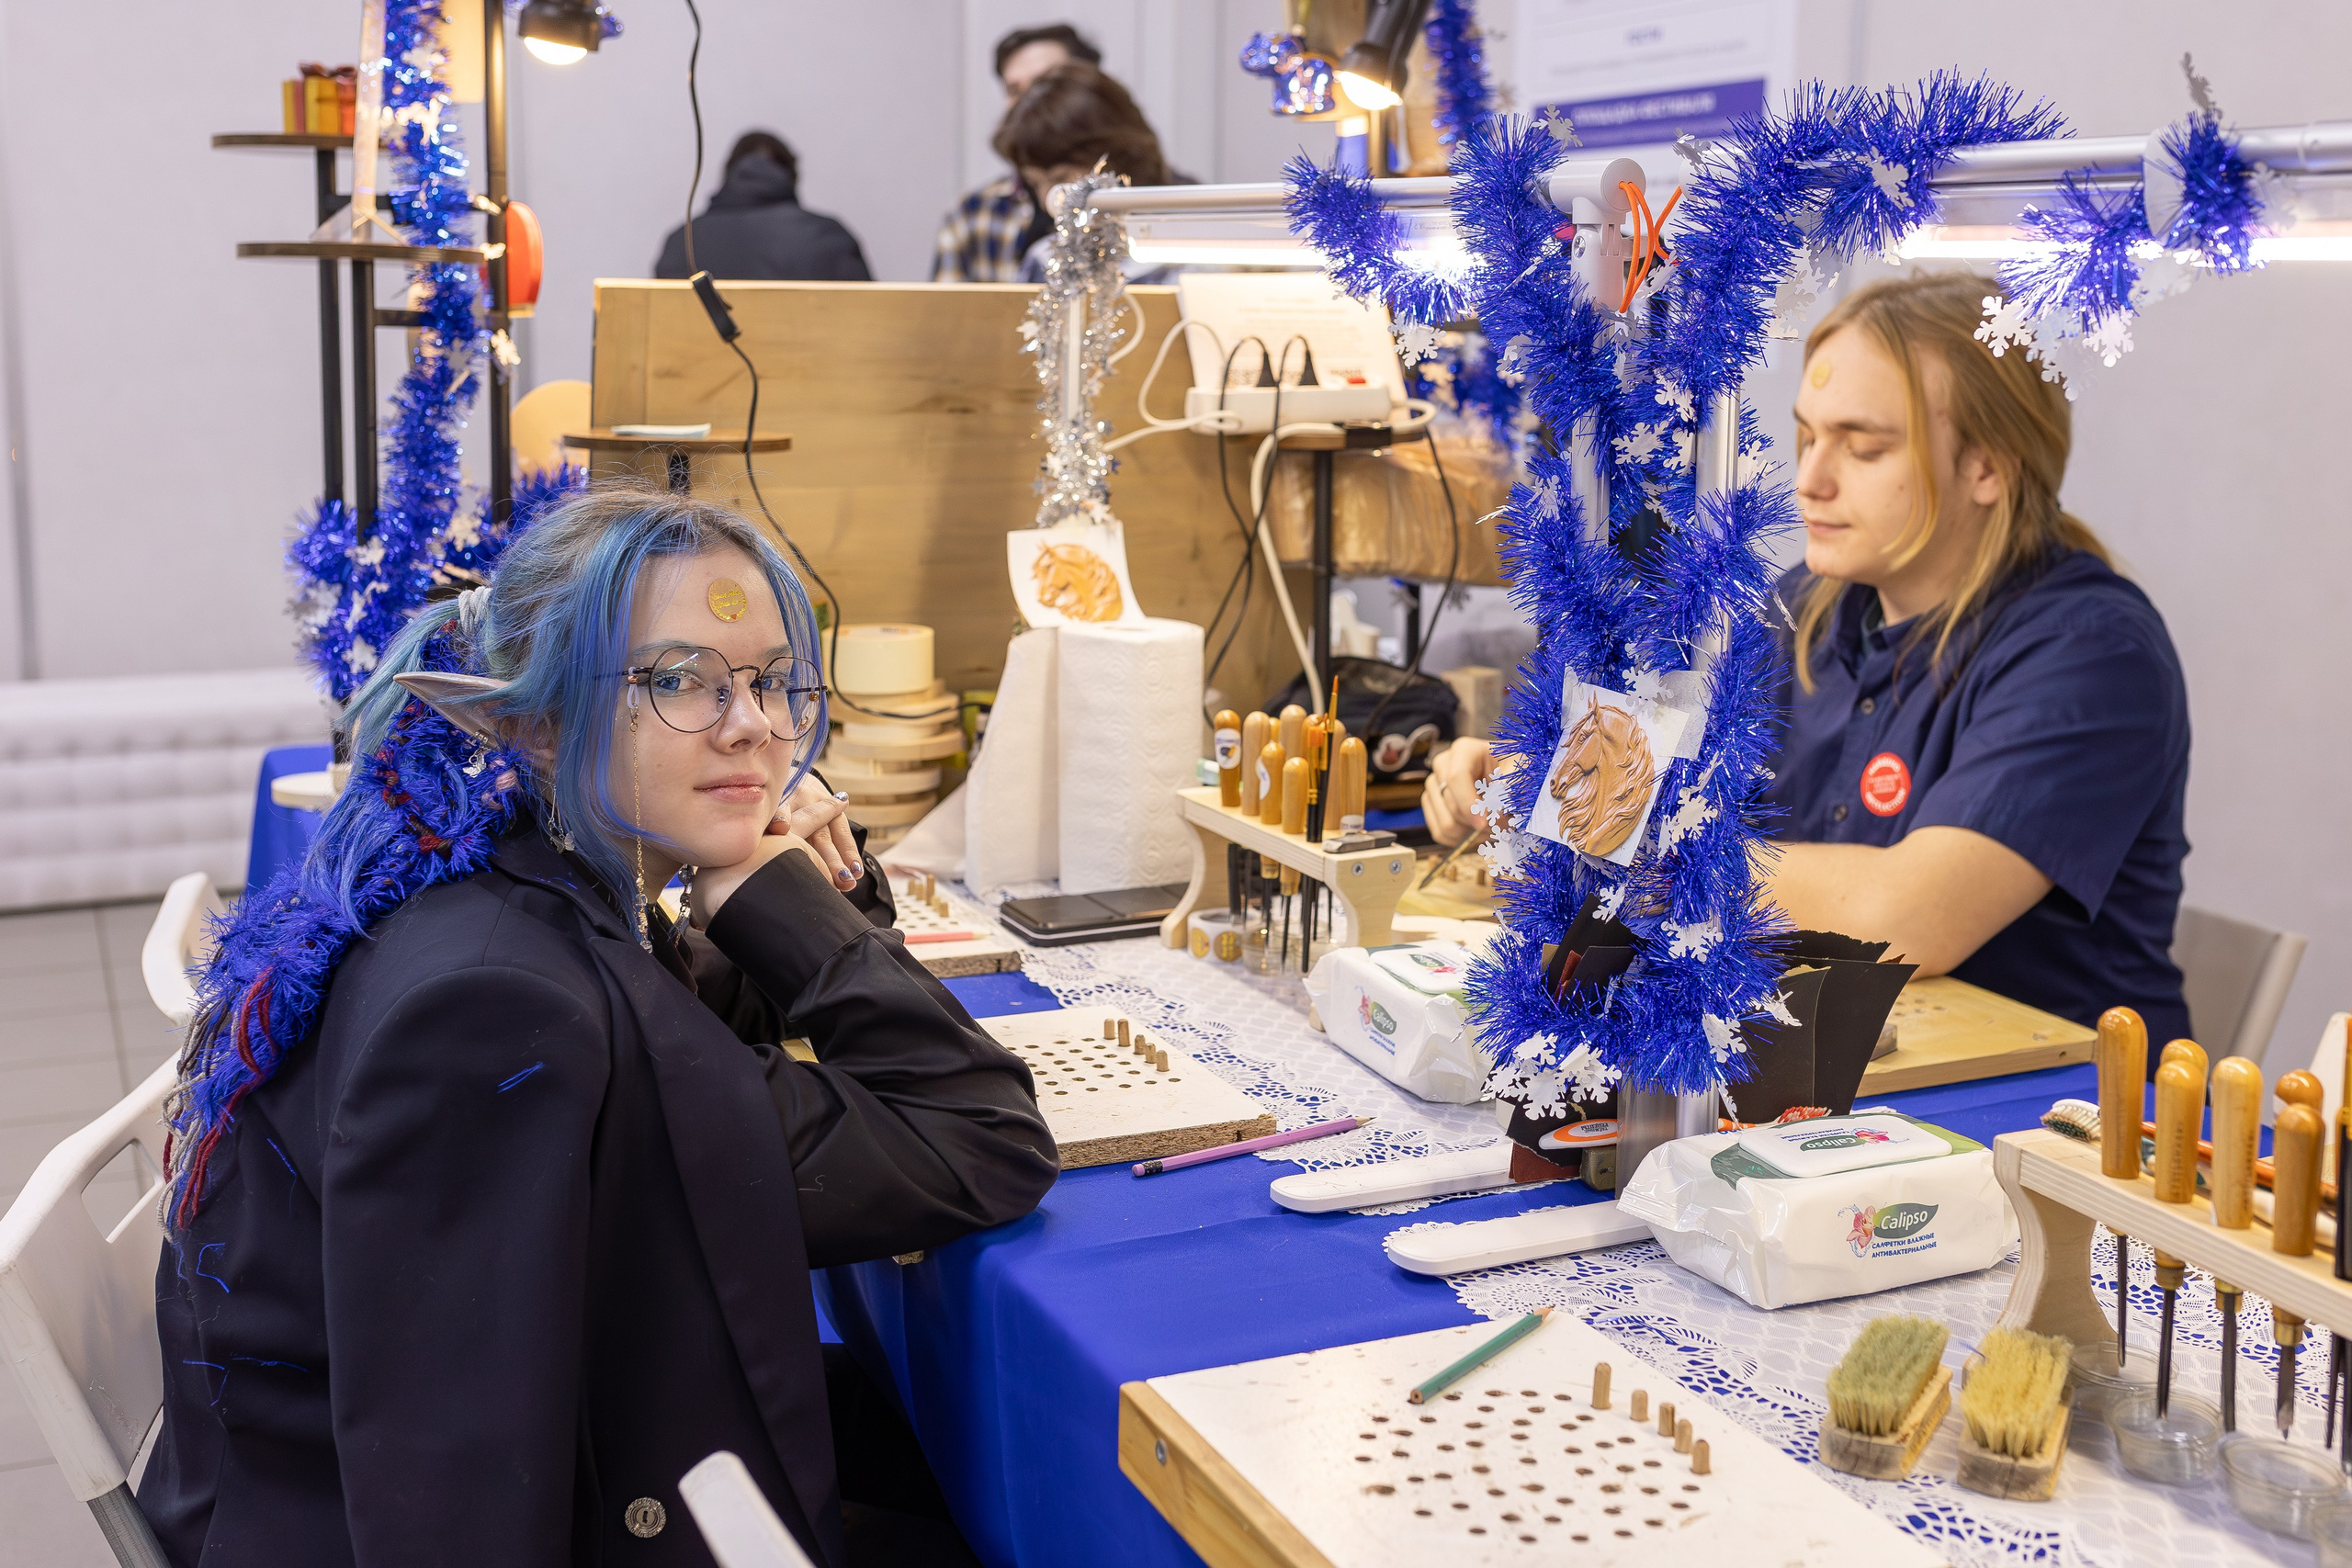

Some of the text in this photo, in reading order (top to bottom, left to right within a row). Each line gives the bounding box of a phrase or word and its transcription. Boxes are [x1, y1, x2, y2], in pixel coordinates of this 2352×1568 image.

[1806, 1137, 1857, 1149] Calipso
[1881, 1210, 1928, 1231] Calipso
[1871, 1232, 1935, 1249] САЛФЕТКИ ВЛАЖНЫЕ
[1871, 1241, 1938, 1258] АНТИБАКТЕРИАЛЬНЫЕ
